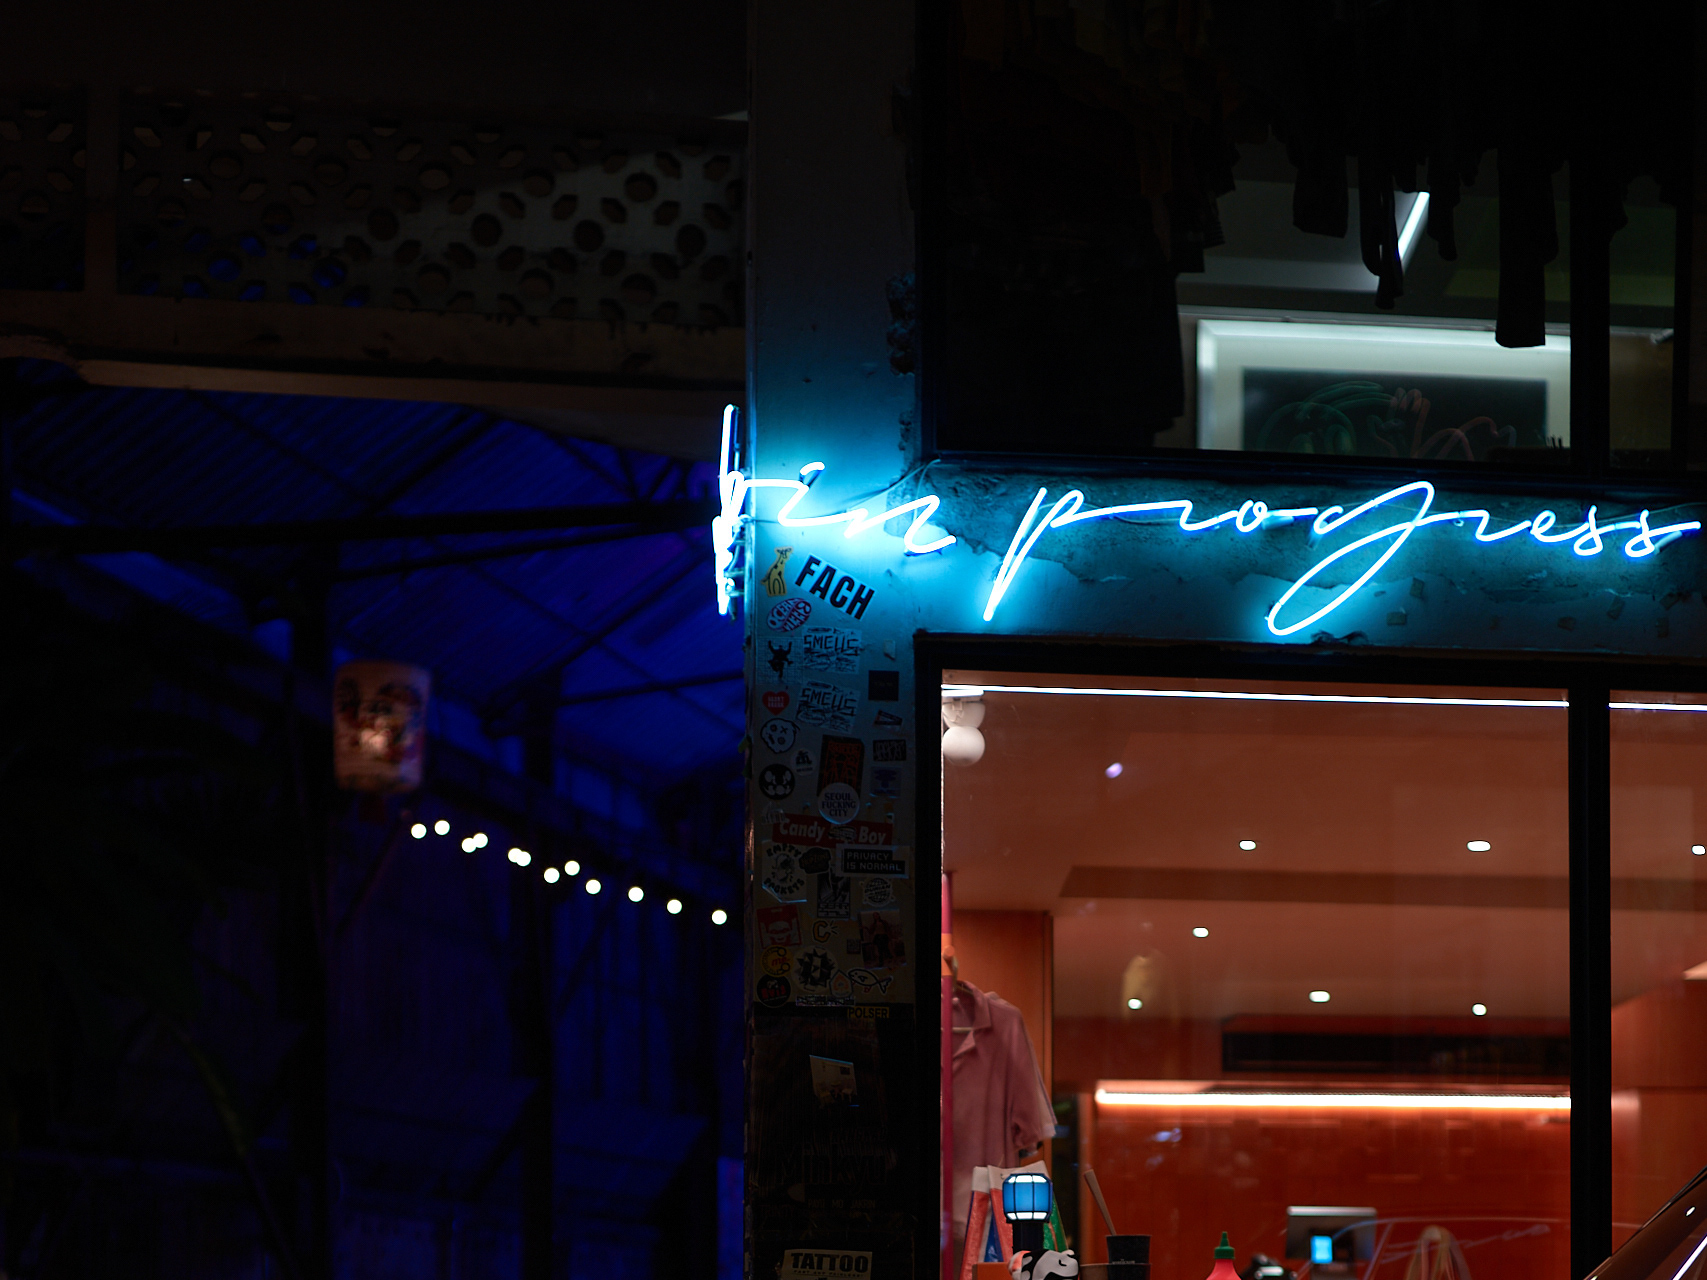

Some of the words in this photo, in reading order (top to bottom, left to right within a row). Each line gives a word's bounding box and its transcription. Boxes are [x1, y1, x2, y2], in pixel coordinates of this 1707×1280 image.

[983, 481, 1702, 636] progress
[795, 555, 875, 620] FACH
[824, 792, 853, 801] SEOUL
[822, 801, 856, 809] FUCKING
[829, 808, 848, 817] CITY
[779, 818, 825, 843] Candy
[858, 826, 886, 846] Boy
[847, 851, 889, 861] PRIVACY
[847, 862, 856, 870] IS
[859, 862, 902, 871] NORMAL
[848, 1007, 889, 1018] POLSER
[791, 1253, 868, 1273] TATTOO
